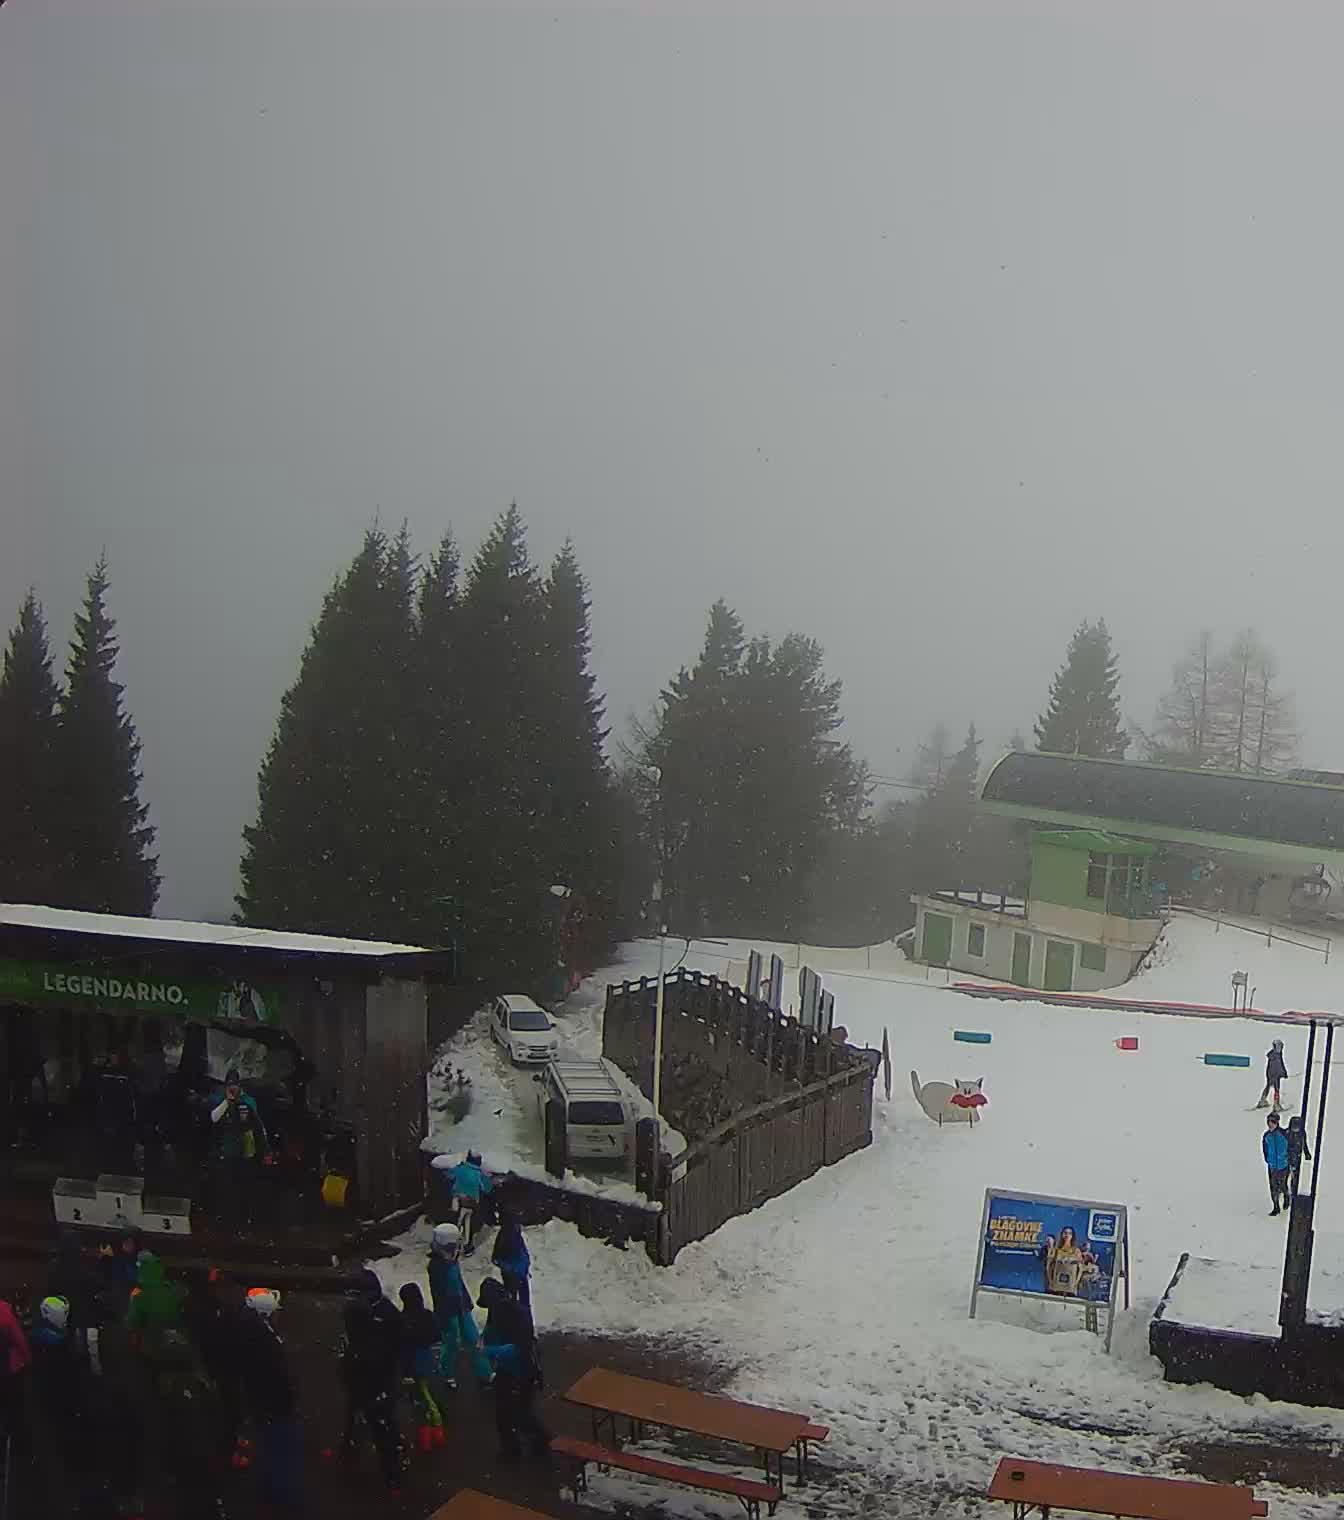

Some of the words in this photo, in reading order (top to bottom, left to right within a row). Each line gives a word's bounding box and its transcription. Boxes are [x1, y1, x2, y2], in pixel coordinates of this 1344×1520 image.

[44, 972, 190, 1005] LEGENDARNO.
[73, 1208, 82, 1221] 2
[162, 1218, 171, 1230] 3
